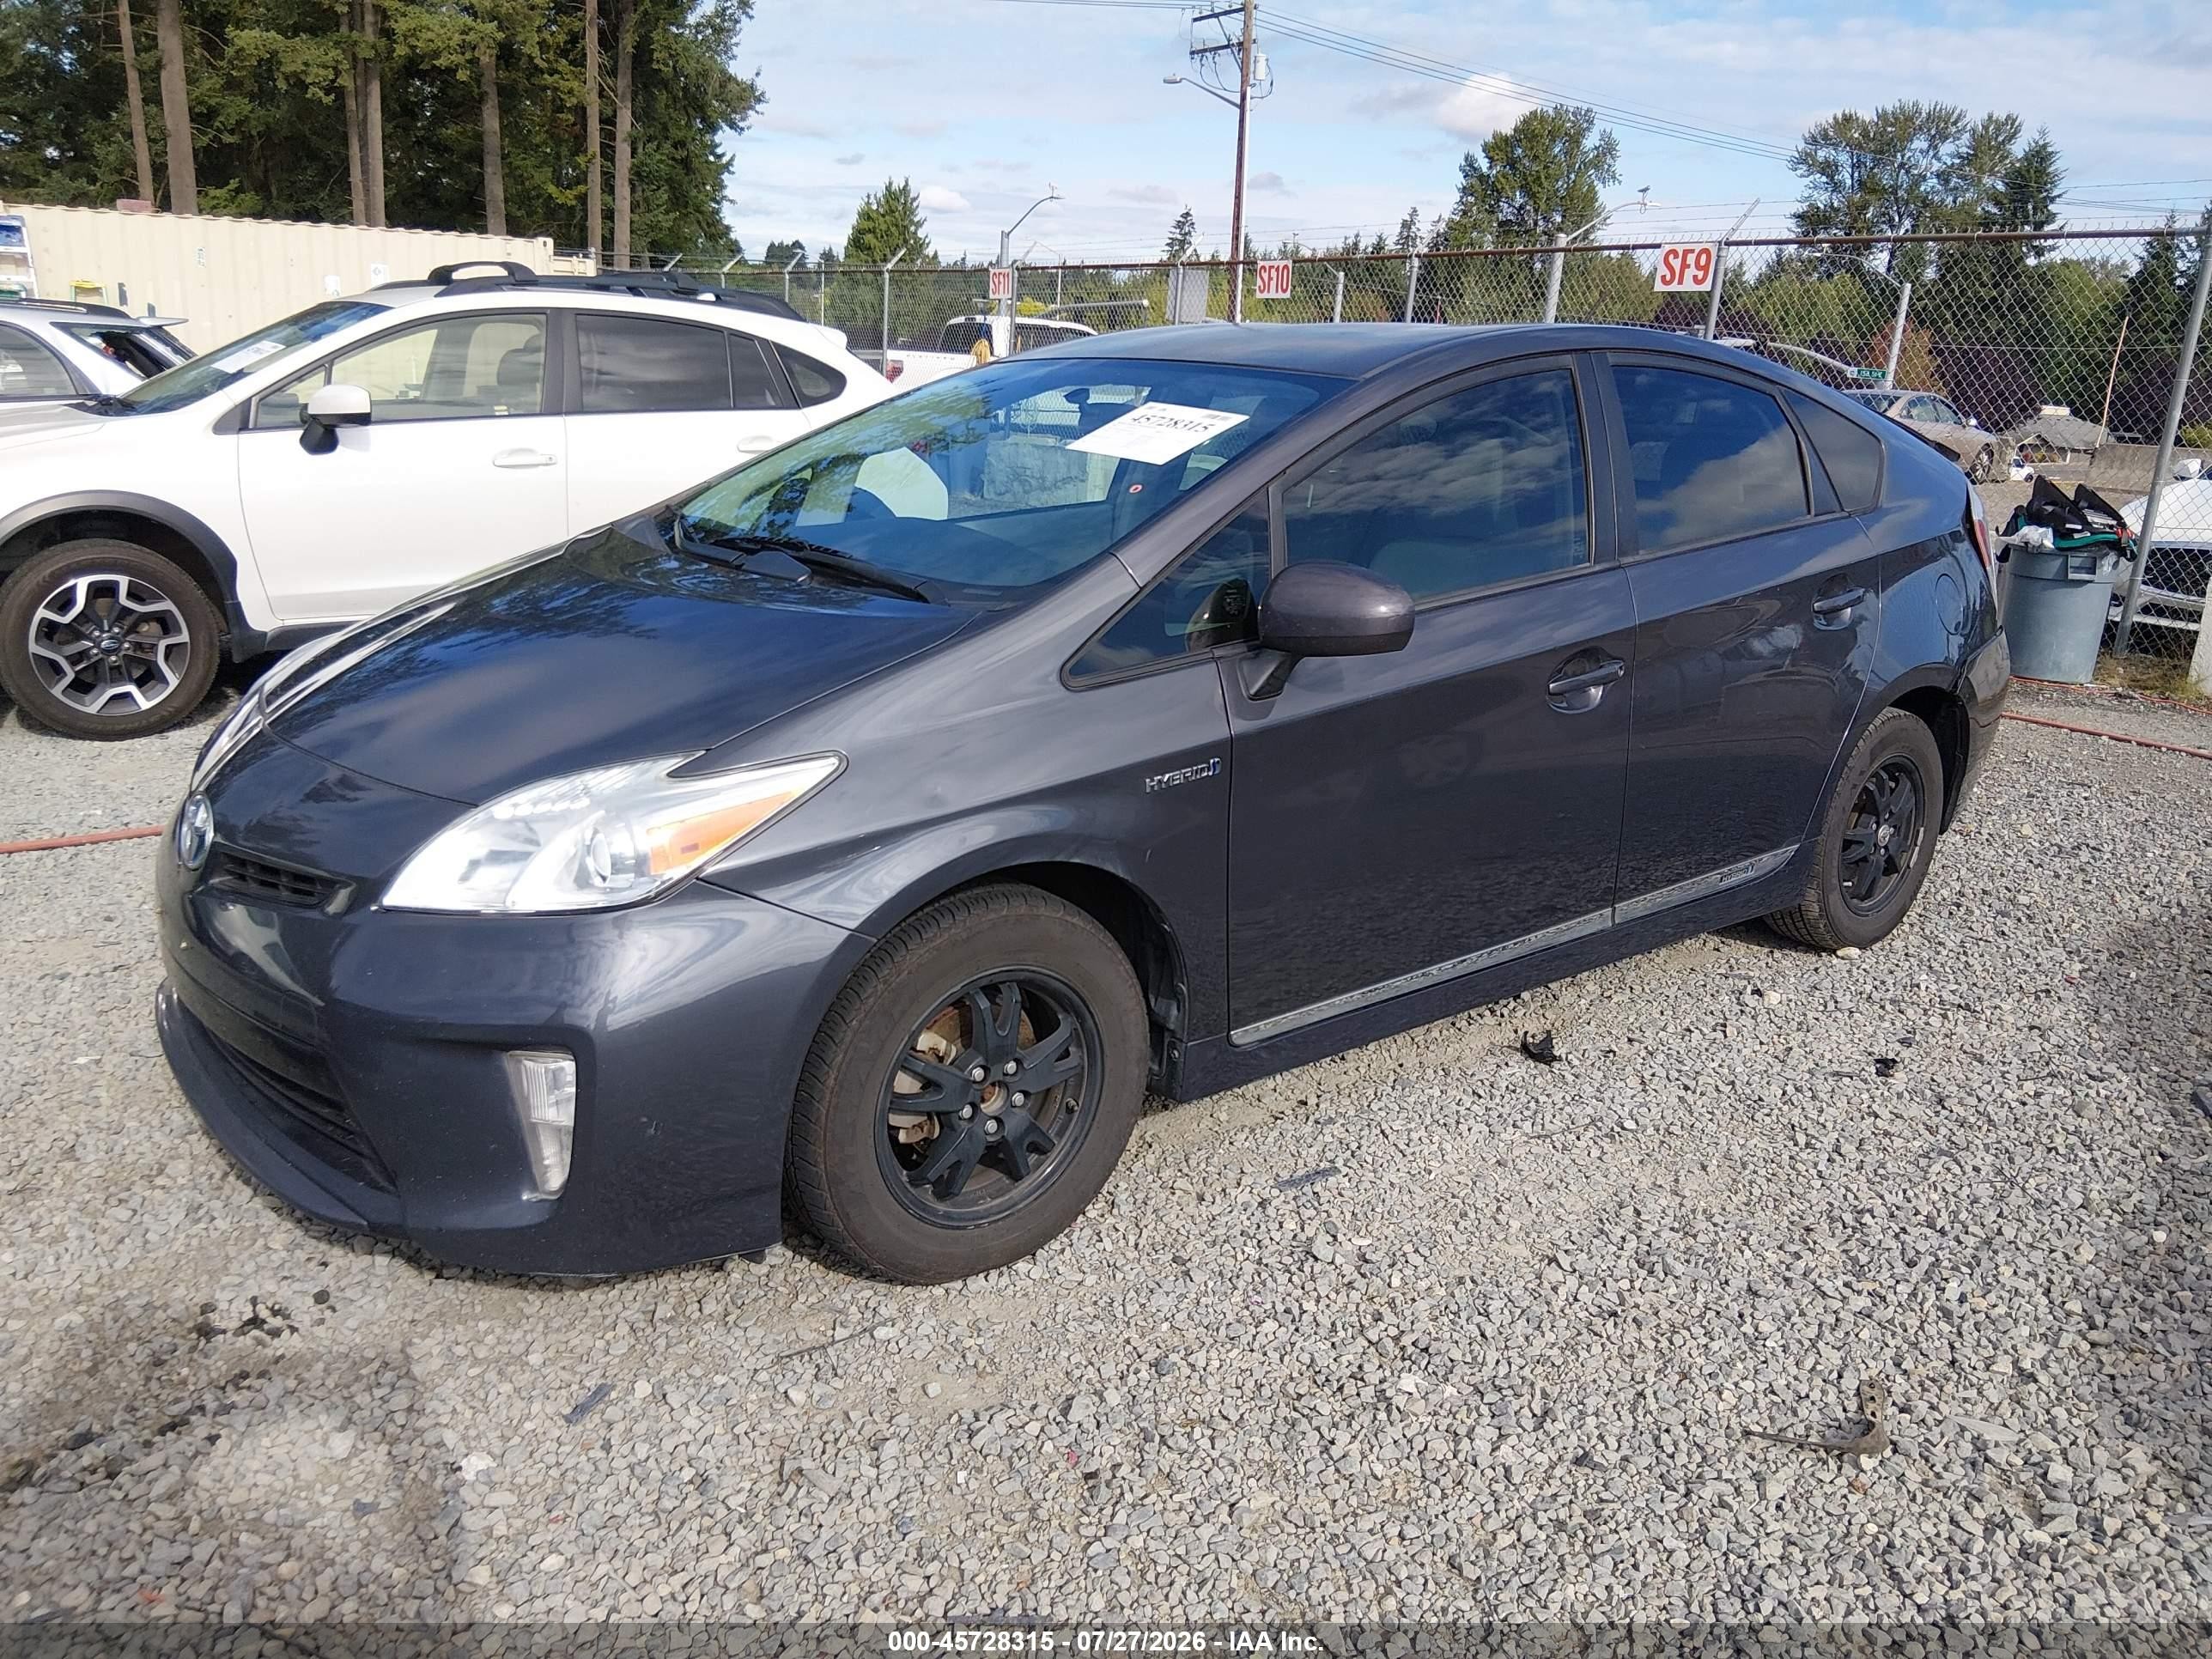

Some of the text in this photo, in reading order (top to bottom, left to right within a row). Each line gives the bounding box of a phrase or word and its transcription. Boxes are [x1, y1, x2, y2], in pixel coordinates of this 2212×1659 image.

[1258, 264, 1291, 294] SF10
[1661, 247, 1712, 286] SF9
[992, 271, 1010, 295] SF11
[1131, 414, 1217, 433] 45728315
[1145, 763, 1210, 793] HYBRID
